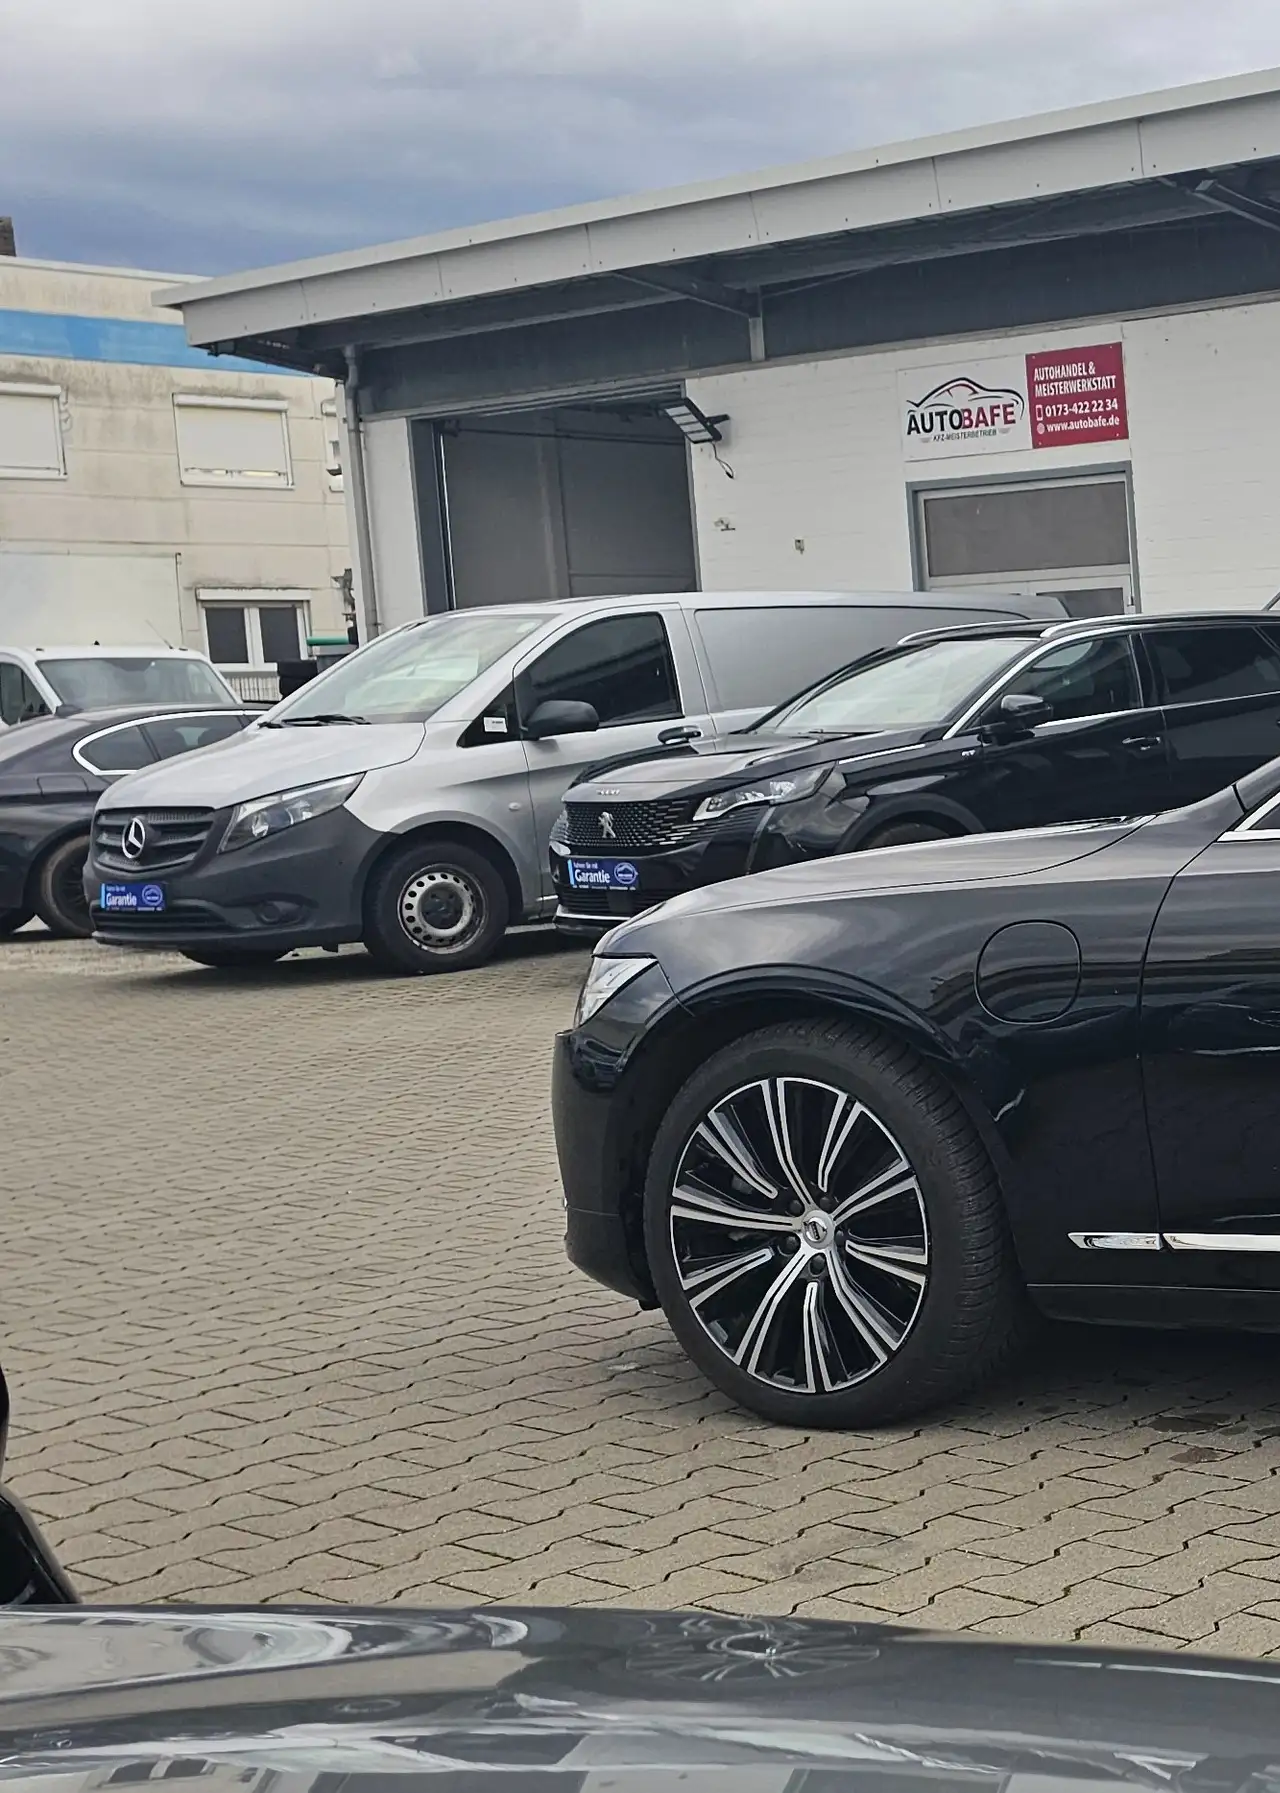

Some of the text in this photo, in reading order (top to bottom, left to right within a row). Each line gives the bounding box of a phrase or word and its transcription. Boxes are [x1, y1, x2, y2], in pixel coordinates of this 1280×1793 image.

[1033, 361, 1096, 382] AUTOHANDEL &
[1034, 375, 1116, 398] MEISTERWERKSTATT
[1045, 398, 1118, 418] 0173-422 22 34
[907, 403, 1016, 435] AUTOBAFE
[1046, 415, 1120, 433] www.autobafe.de
[574, 869, 611, 884] Garantie
[106, 892, 137, 906] Garantie
